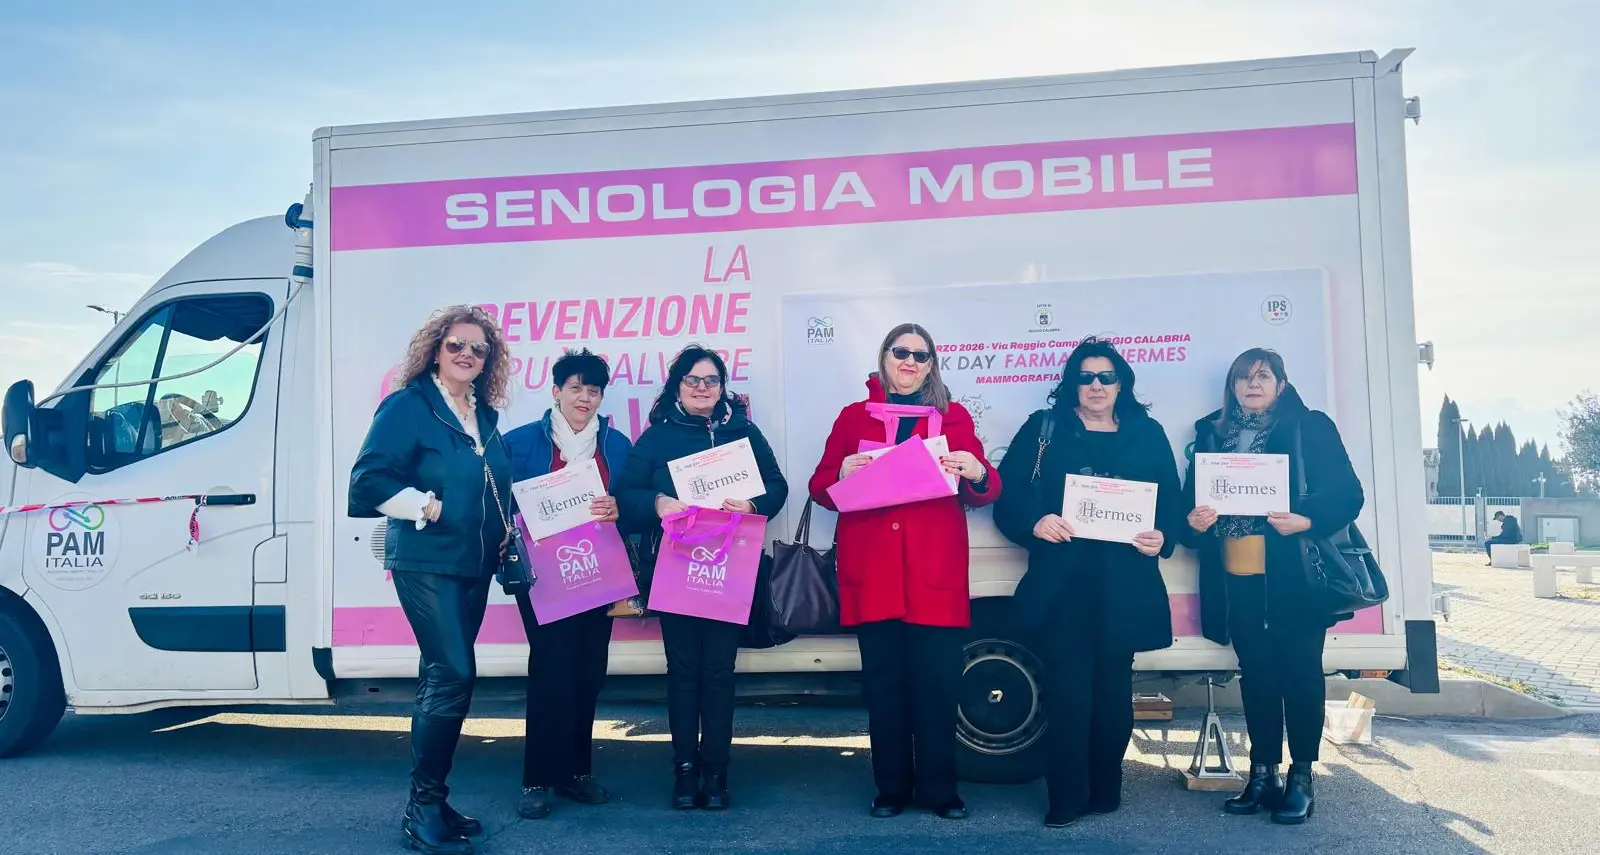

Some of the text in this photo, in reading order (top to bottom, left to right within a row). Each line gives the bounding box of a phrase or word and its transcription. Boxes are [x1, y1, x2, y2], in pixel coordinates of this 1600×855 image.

[445, 148, 1213, 230] SENOLOGIA MOBILE
[703, 245, 751, 282] LA
[1267, 300, 1287, 312] IPS
[479, 293, 752, 342] EVENZIONE
[807, 327, 834, 338] PAM
[936, 344, 957, 352] RZO
[959, 343, 985, 352] 2026
[992, 342, 1008, 350] Via
[1010, 341, 1046, 351] Reggio
[1134, 334, 1191, 343] CALABRIA
[957, 354, 996, 371] DAY
[1005, 352, 1068, 368] FARMA
[975, 373, 1061, 384] MAMMOGRAFIA
[692, 470, 749, 495] Hermes
[1215, 478, 1277, 495] Hermes
[540, 490, 596, 516] Hermes
[1082, 501, 1142, 523] Hermes
[46, 531, 105, 556] PAM
[46, 557, 104, 568] ITALIA
[559, 554, 599, 577] PAM
[687, 561, 727, 580] PAM
[563, 567, 601, 584] ITALIA
[686, 575, 724, 588] ITALIA
